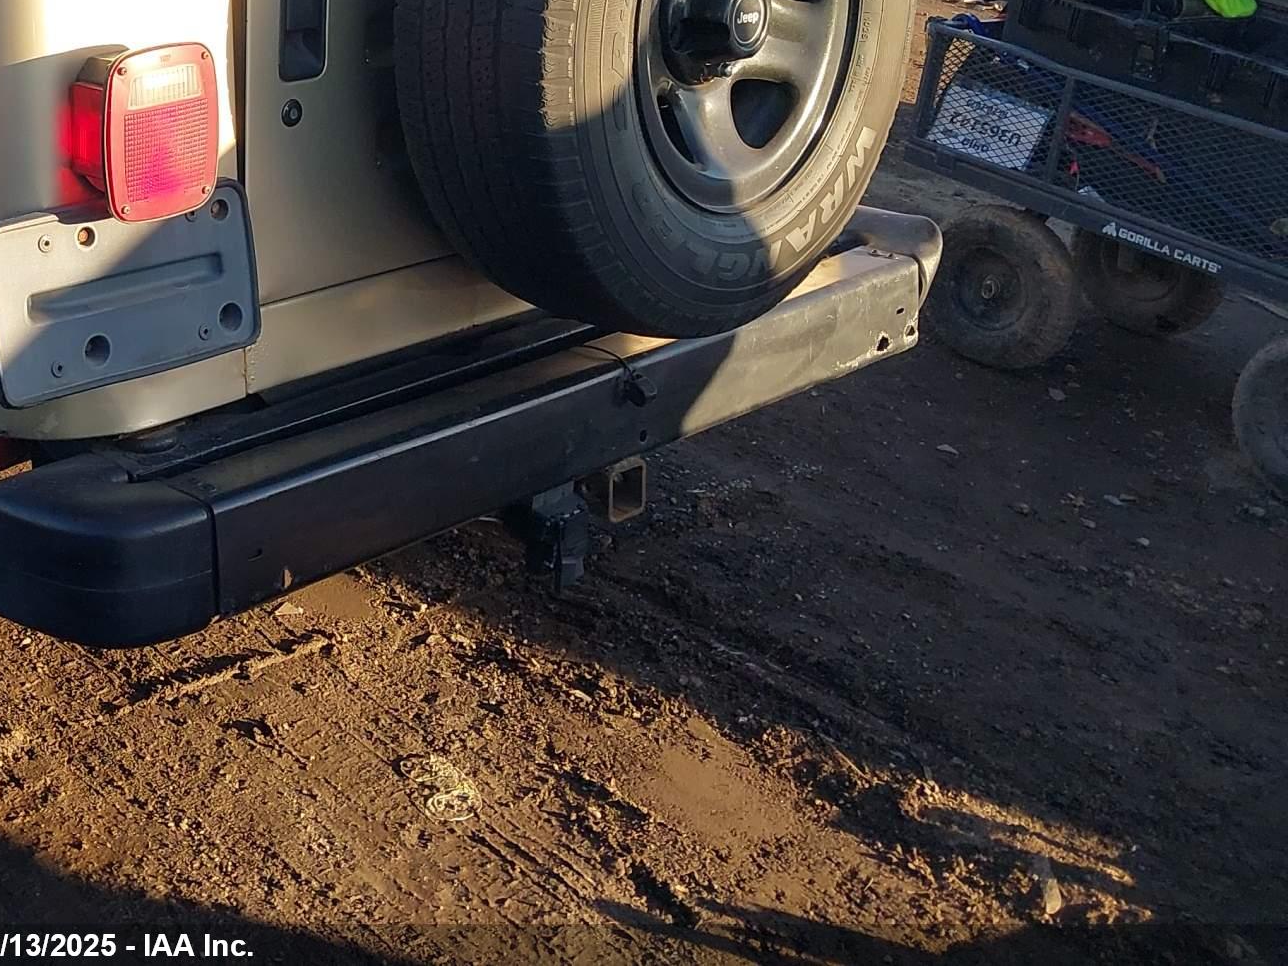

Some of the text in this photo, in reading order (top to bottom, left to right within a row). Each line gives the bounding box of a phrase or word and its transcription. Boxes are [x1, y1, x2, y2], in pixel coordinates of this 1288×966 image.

[736, 11, 760, 25] Jeep
[1118, 228, 1220, 274] GORILLA CARTS
